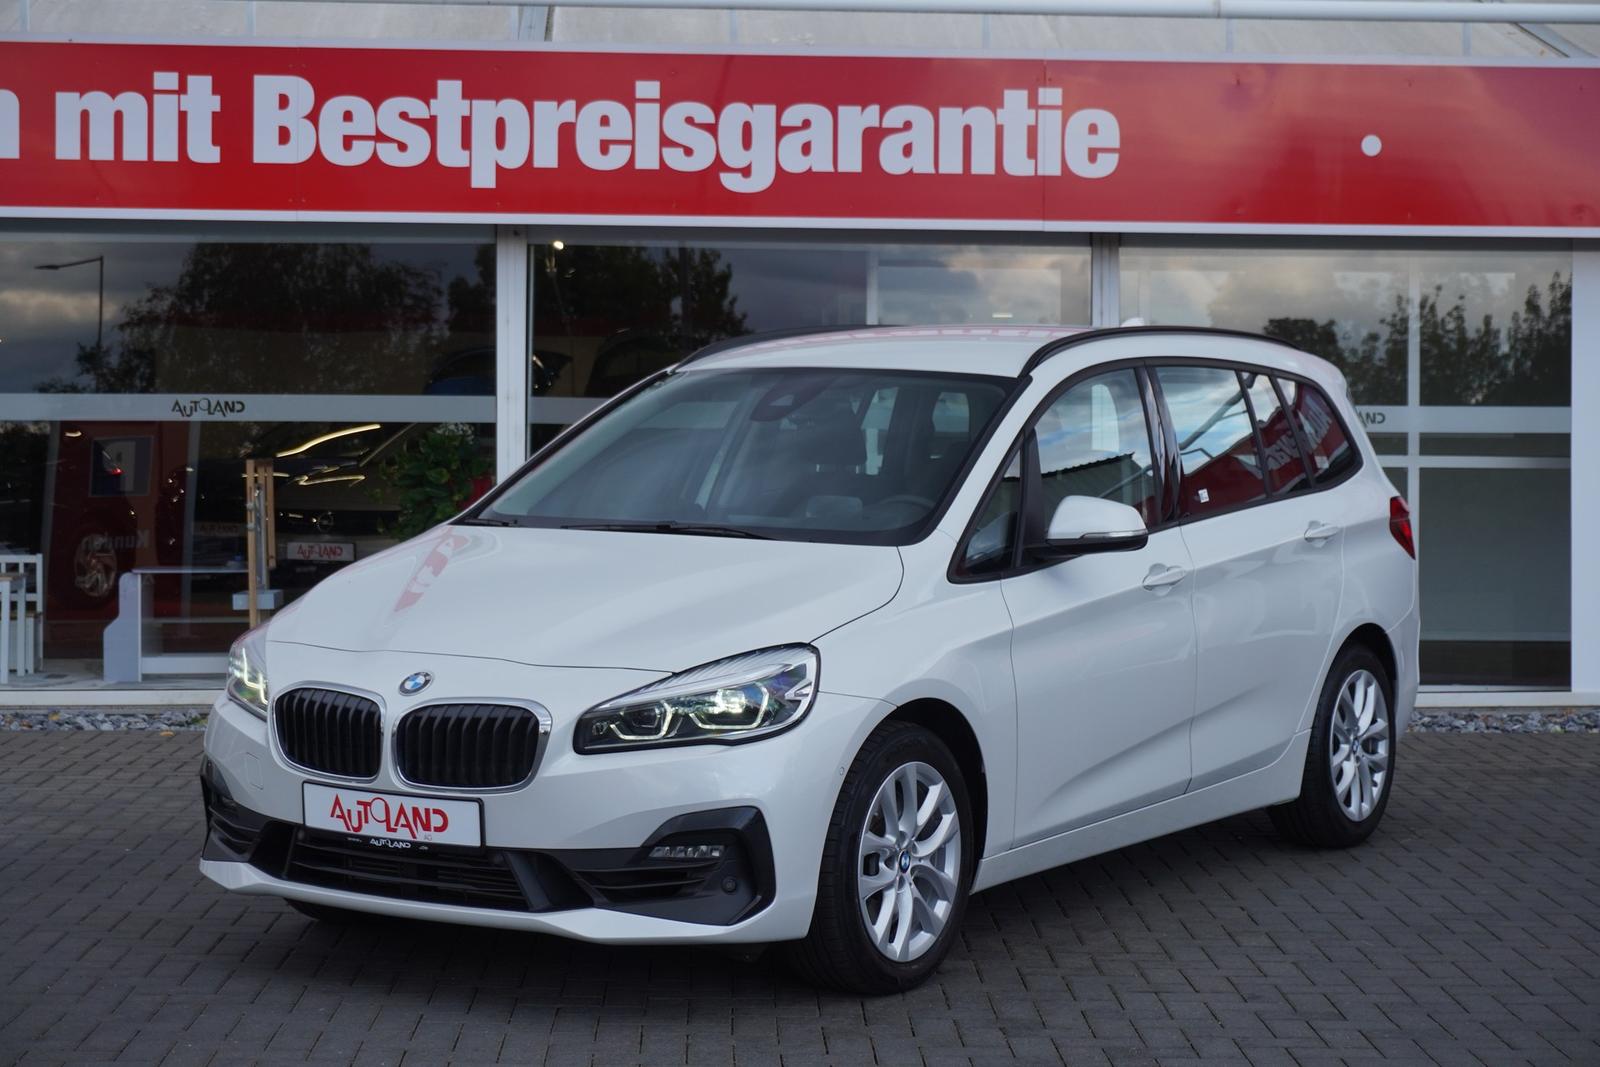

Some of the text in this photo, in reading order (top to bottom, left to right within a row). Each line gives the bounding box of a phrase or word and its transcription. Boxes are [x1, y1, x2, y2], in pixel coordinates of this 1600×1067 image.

[55, 71, 221, 164] mit
[252, 73, 1121, 193] Bestpreisgarantie
[171, 398, 246, 417] AUTOLAND
[330, 793, 449, 839] AUTOLAND
[369, 838, 412, 849] AUTOLAND
